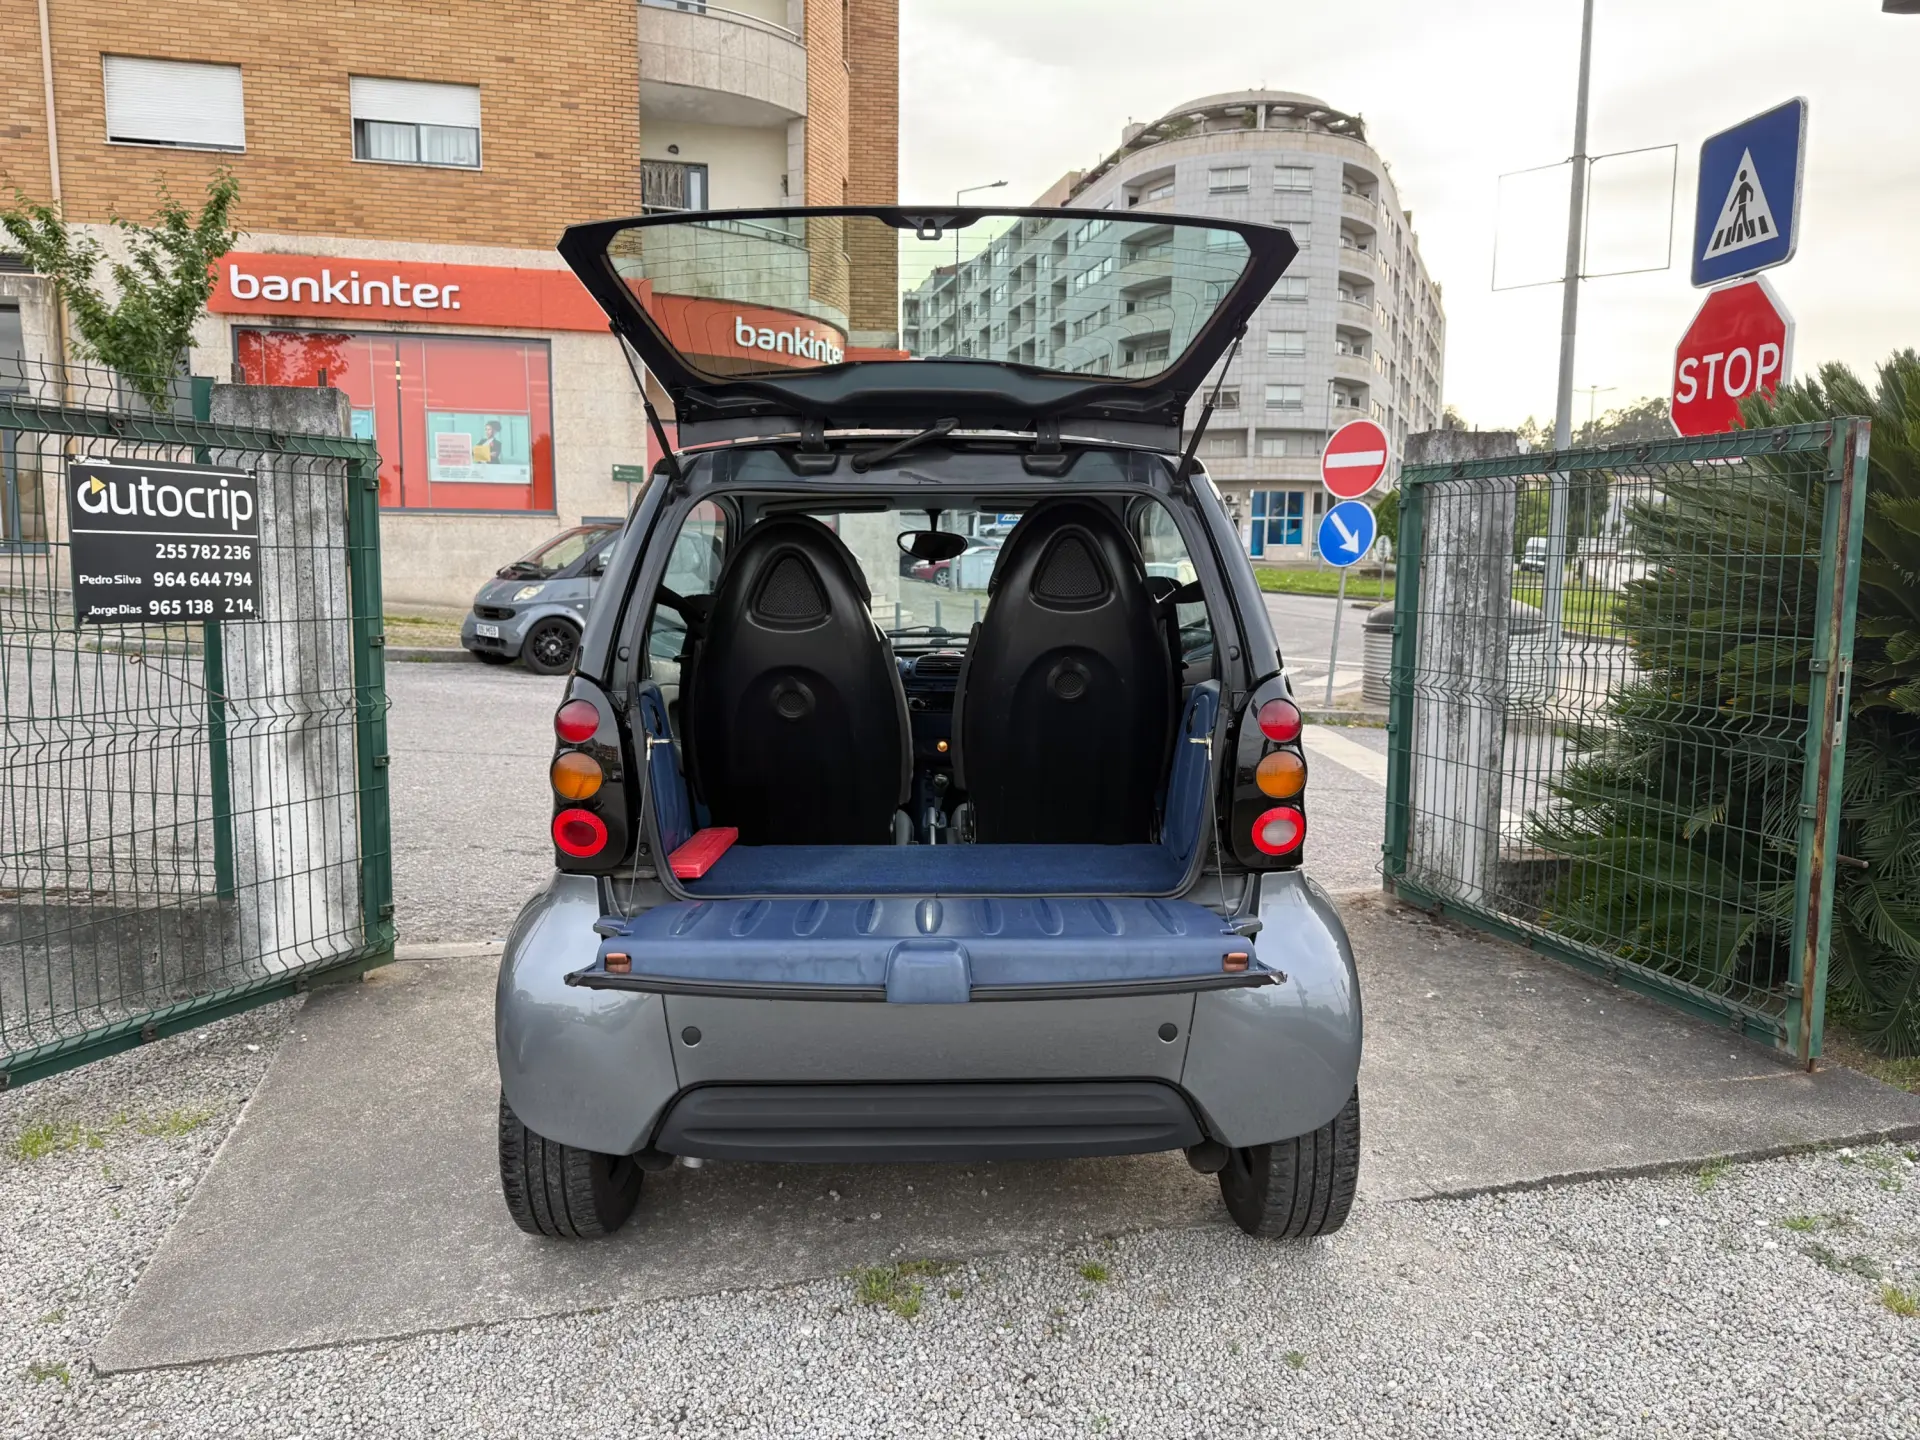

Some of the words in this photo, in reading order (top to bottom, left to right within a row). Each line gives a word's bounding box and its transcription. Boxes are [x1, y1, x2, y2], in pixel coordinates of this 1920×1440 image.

[1676, 342, 1780, 404] STOP
[77, 475, 253, 530] autocrip
[156, 544, 187, 559] 255
[191, 545, 220, 559] 782
[224, 545, 251, 560] 236
[79, 575, 113, 585] Pedro
[114, 575, 142, 584] Silva
[153, 572, 186, 587] 964
[190, 572, 221, 587] 644
[224, 572, 252, 586] 794
[88, 605, 117, 616] Jorge
[119, 605, 142, 614] Dias
[149, 600, 181, 615] 965
[186, 600, 214, 614] 138
